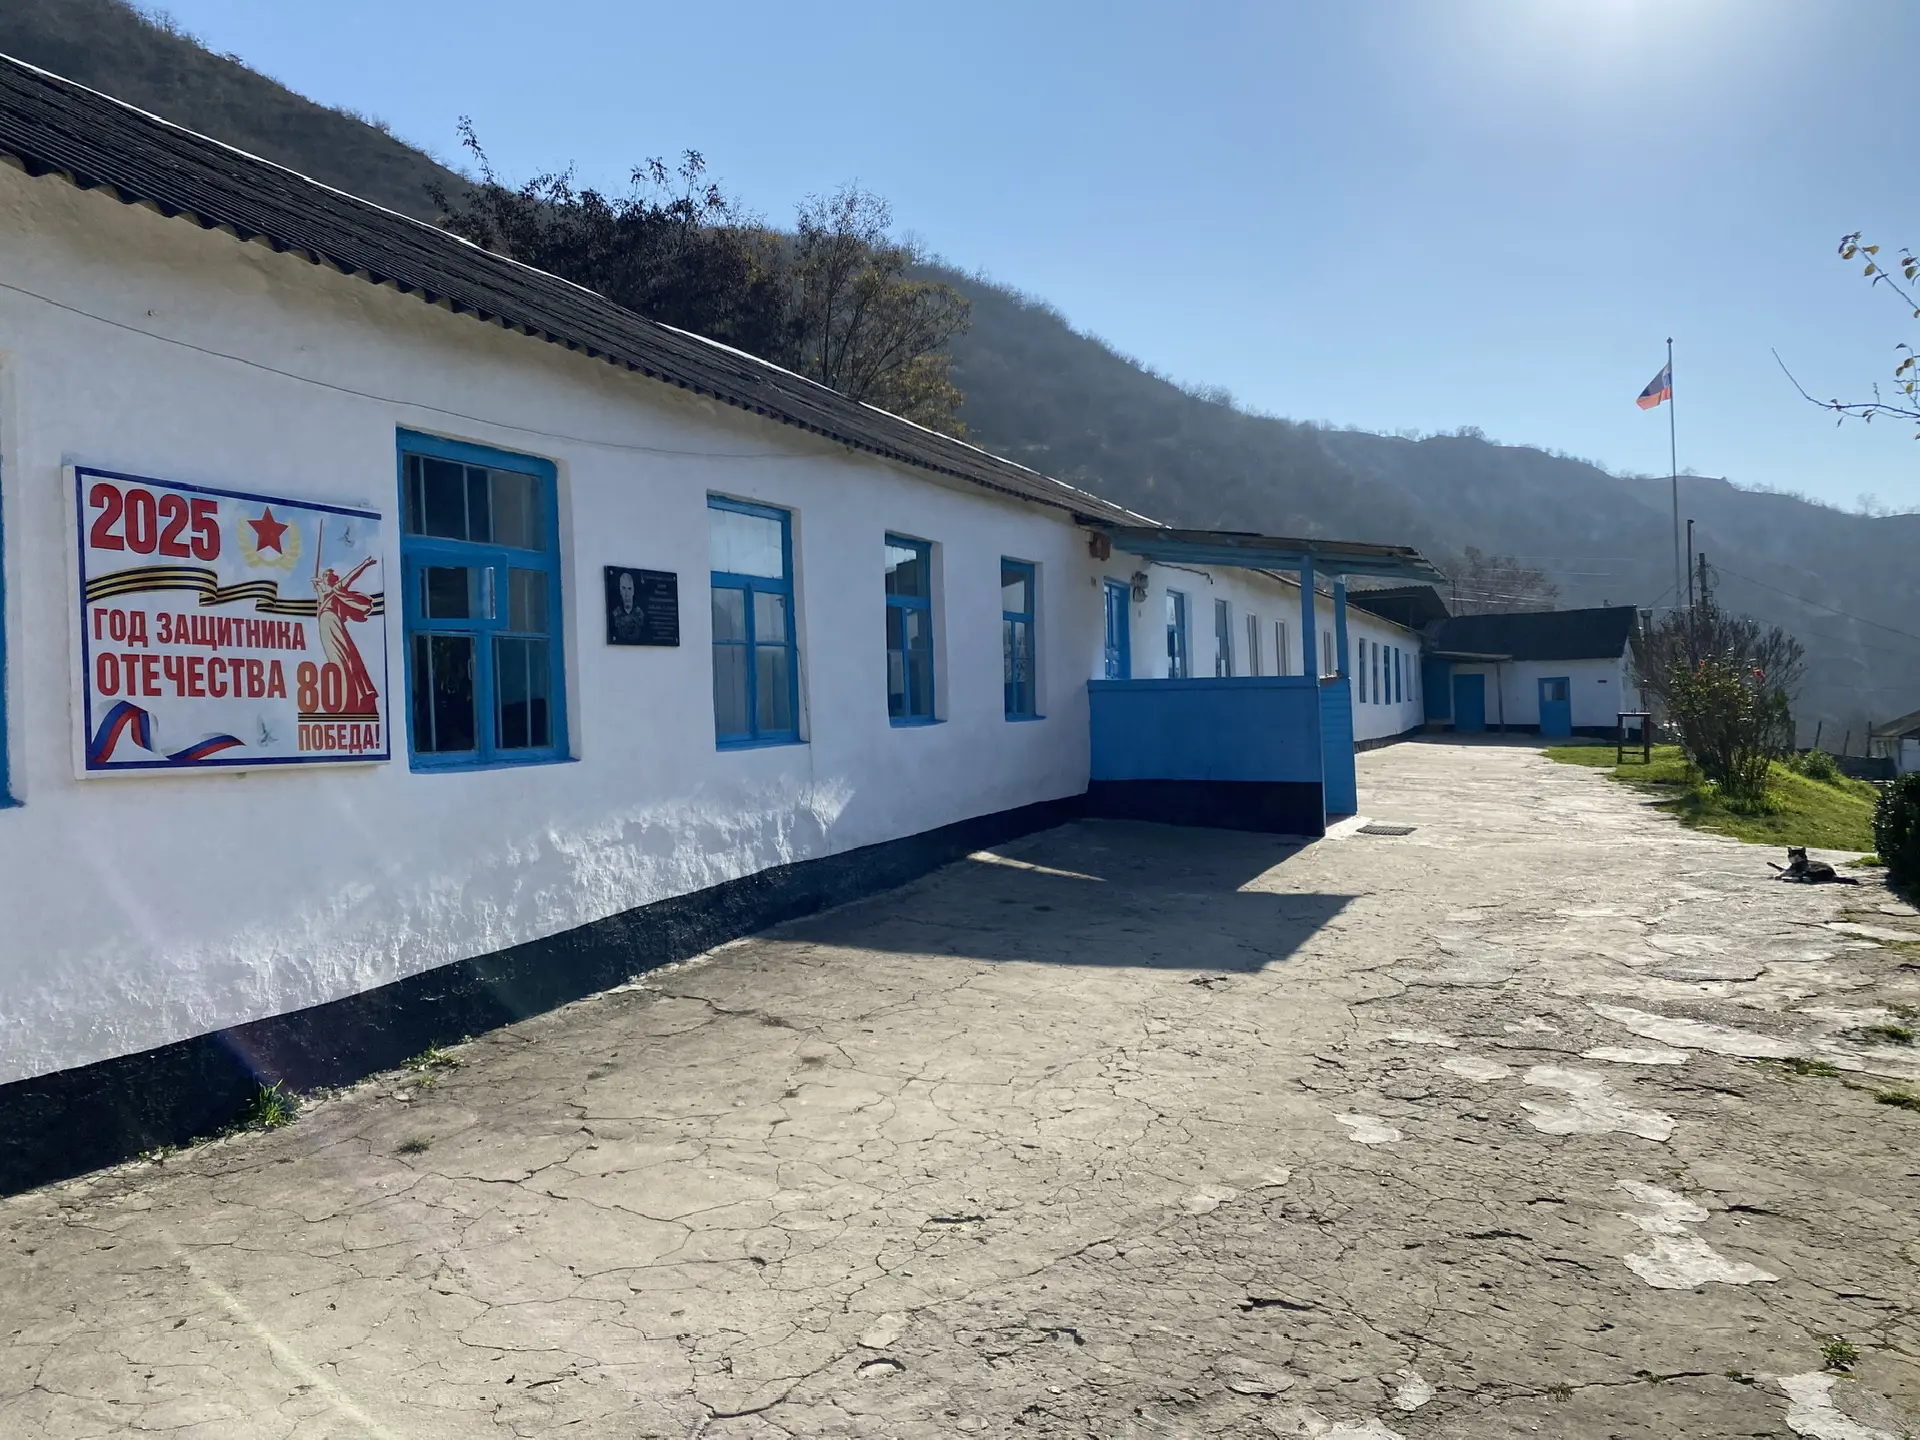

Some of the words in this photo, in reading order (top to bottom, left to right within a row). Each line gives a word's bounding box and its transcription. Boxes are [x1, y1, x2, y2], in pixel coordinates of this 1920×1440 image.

[90, 483, 220, 561] 2025
[94, 608, 148, 647] ГОД
[157, 613, 306, 651] ЗАЩИТНИКА
[96, 653, 287, 699] ОТЕЧЕСТВА
[297, 661, 342, 713] 80
[298, 724, 380, 754] ПОБЕДА!
